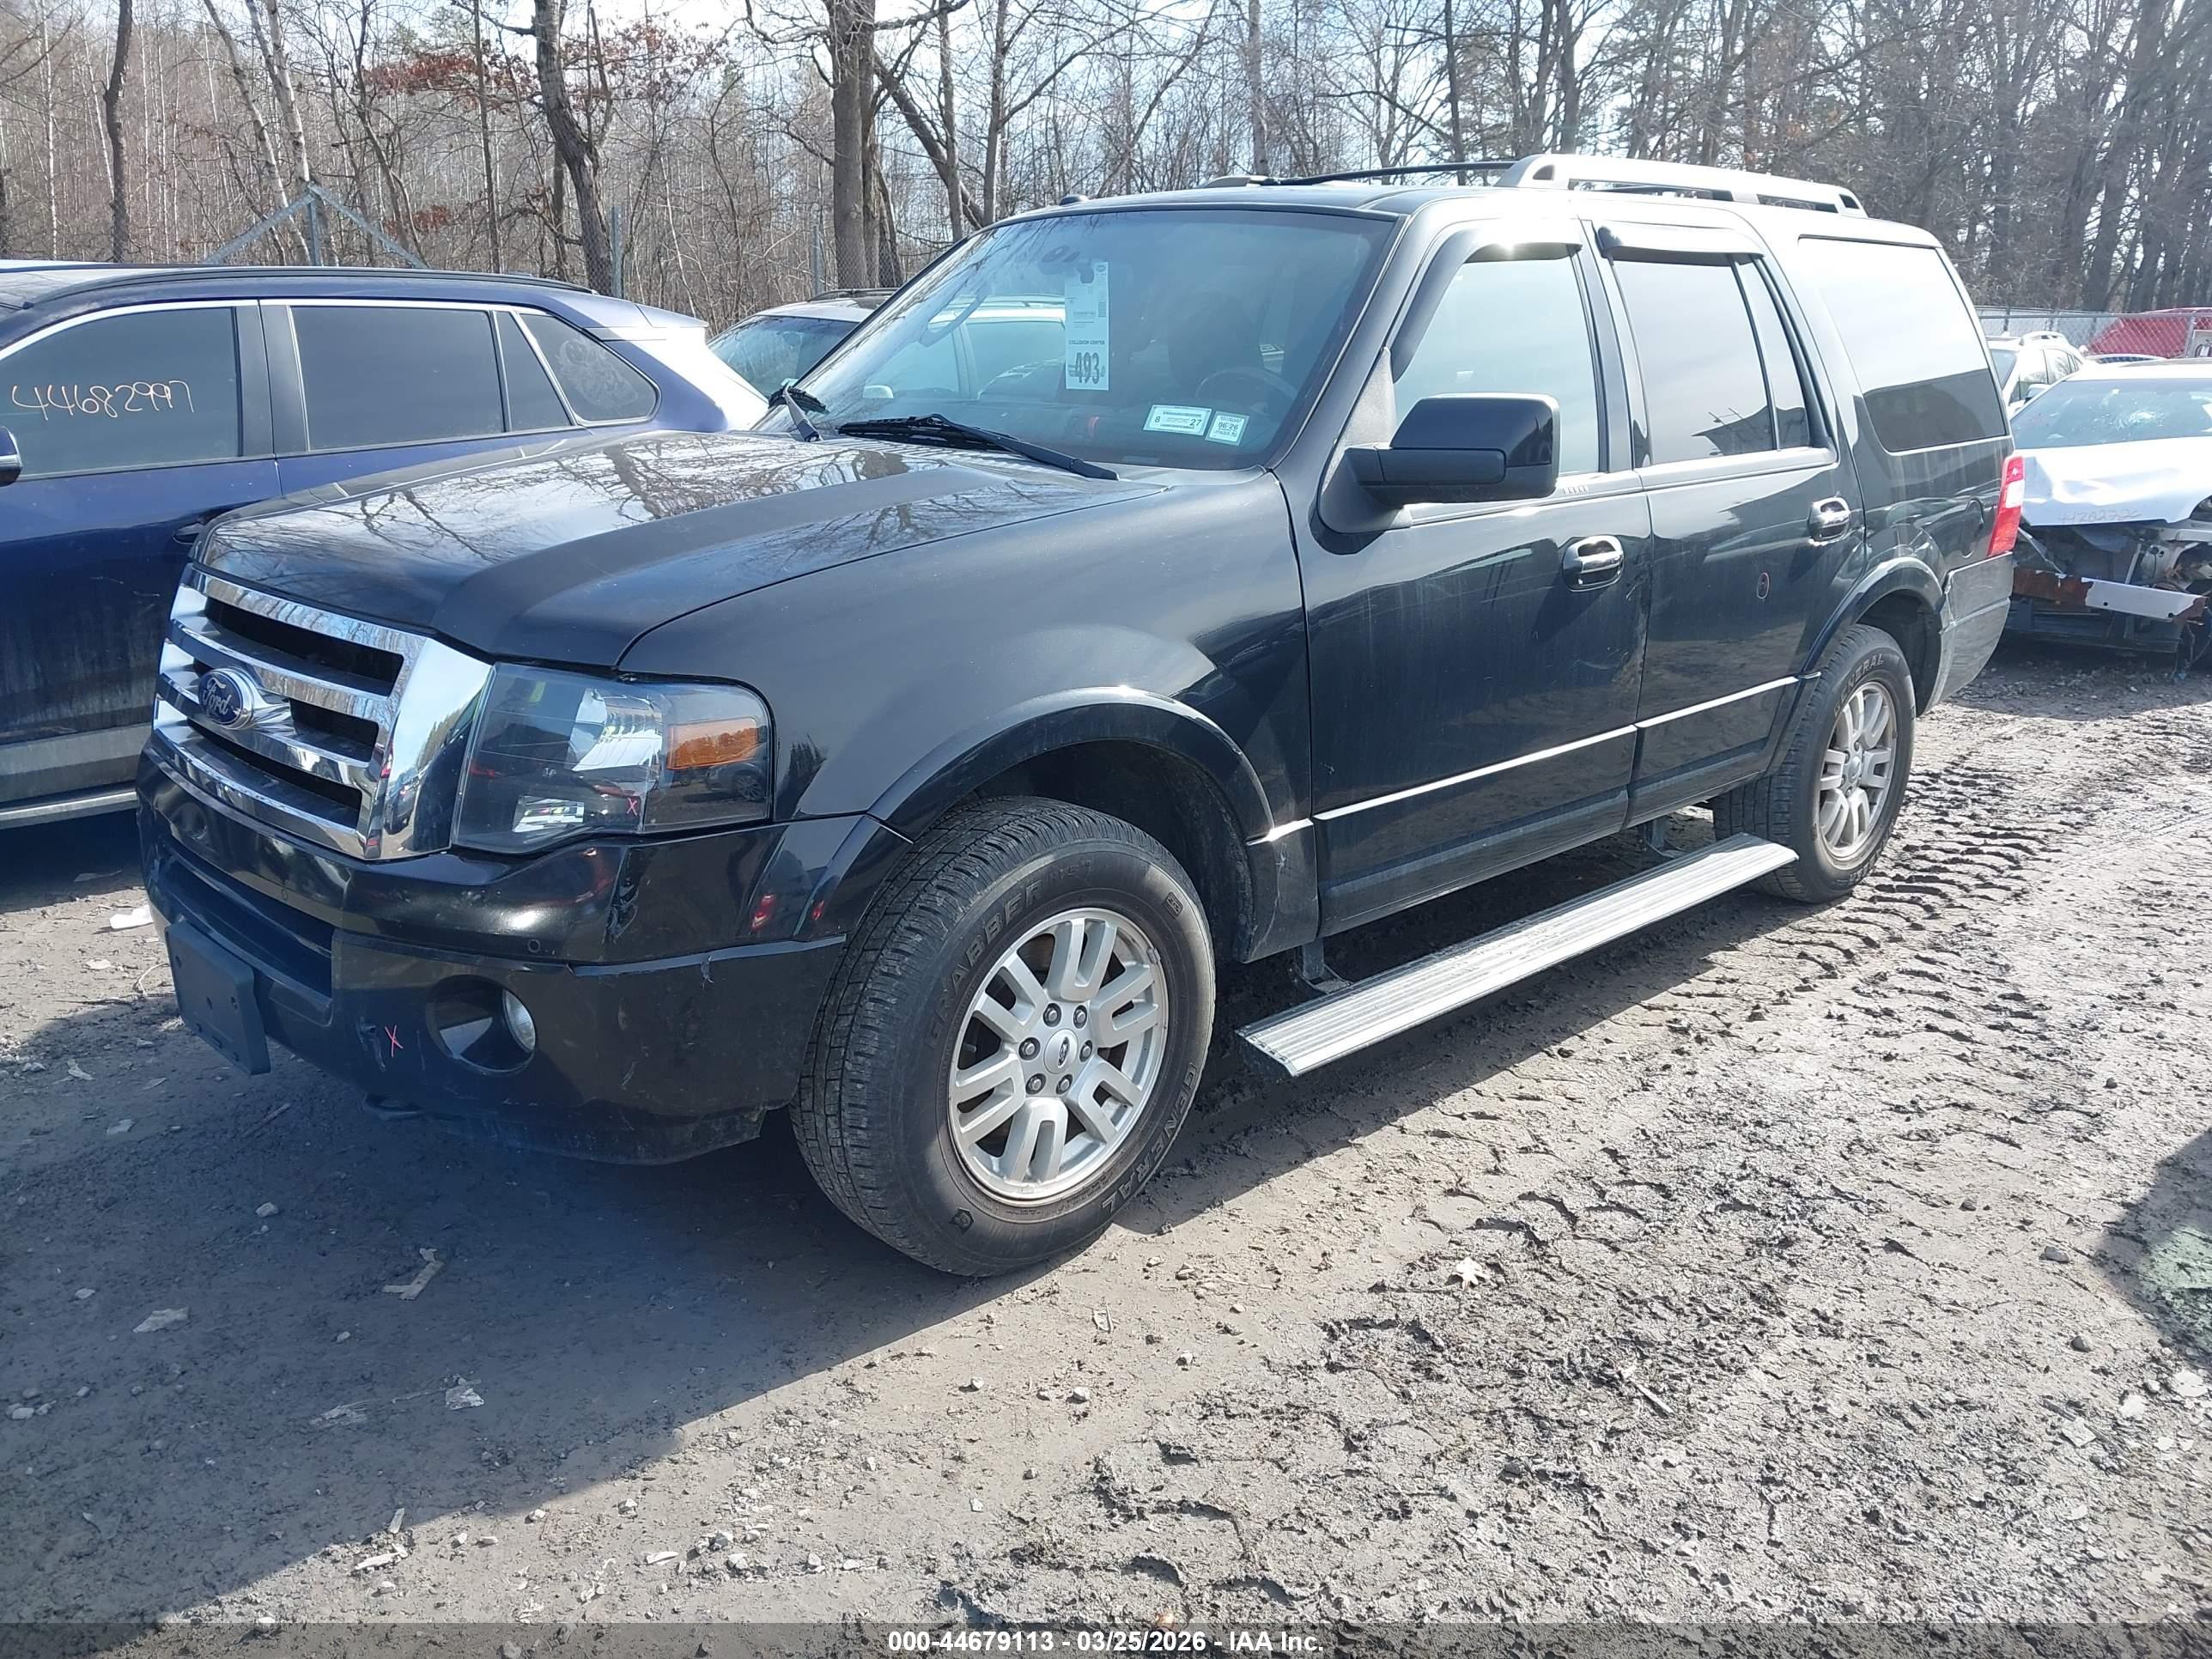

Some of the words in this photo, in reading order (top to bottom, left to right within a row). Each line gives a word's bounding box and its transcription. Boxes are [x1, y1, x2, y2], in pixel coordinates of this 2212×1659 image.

[1074, 351, 1100, 384] 493
[11, 380, 195, 421] 44682997
[1189, 418, 1203, 427] 27
[203, 677, 233, 715] Ford
